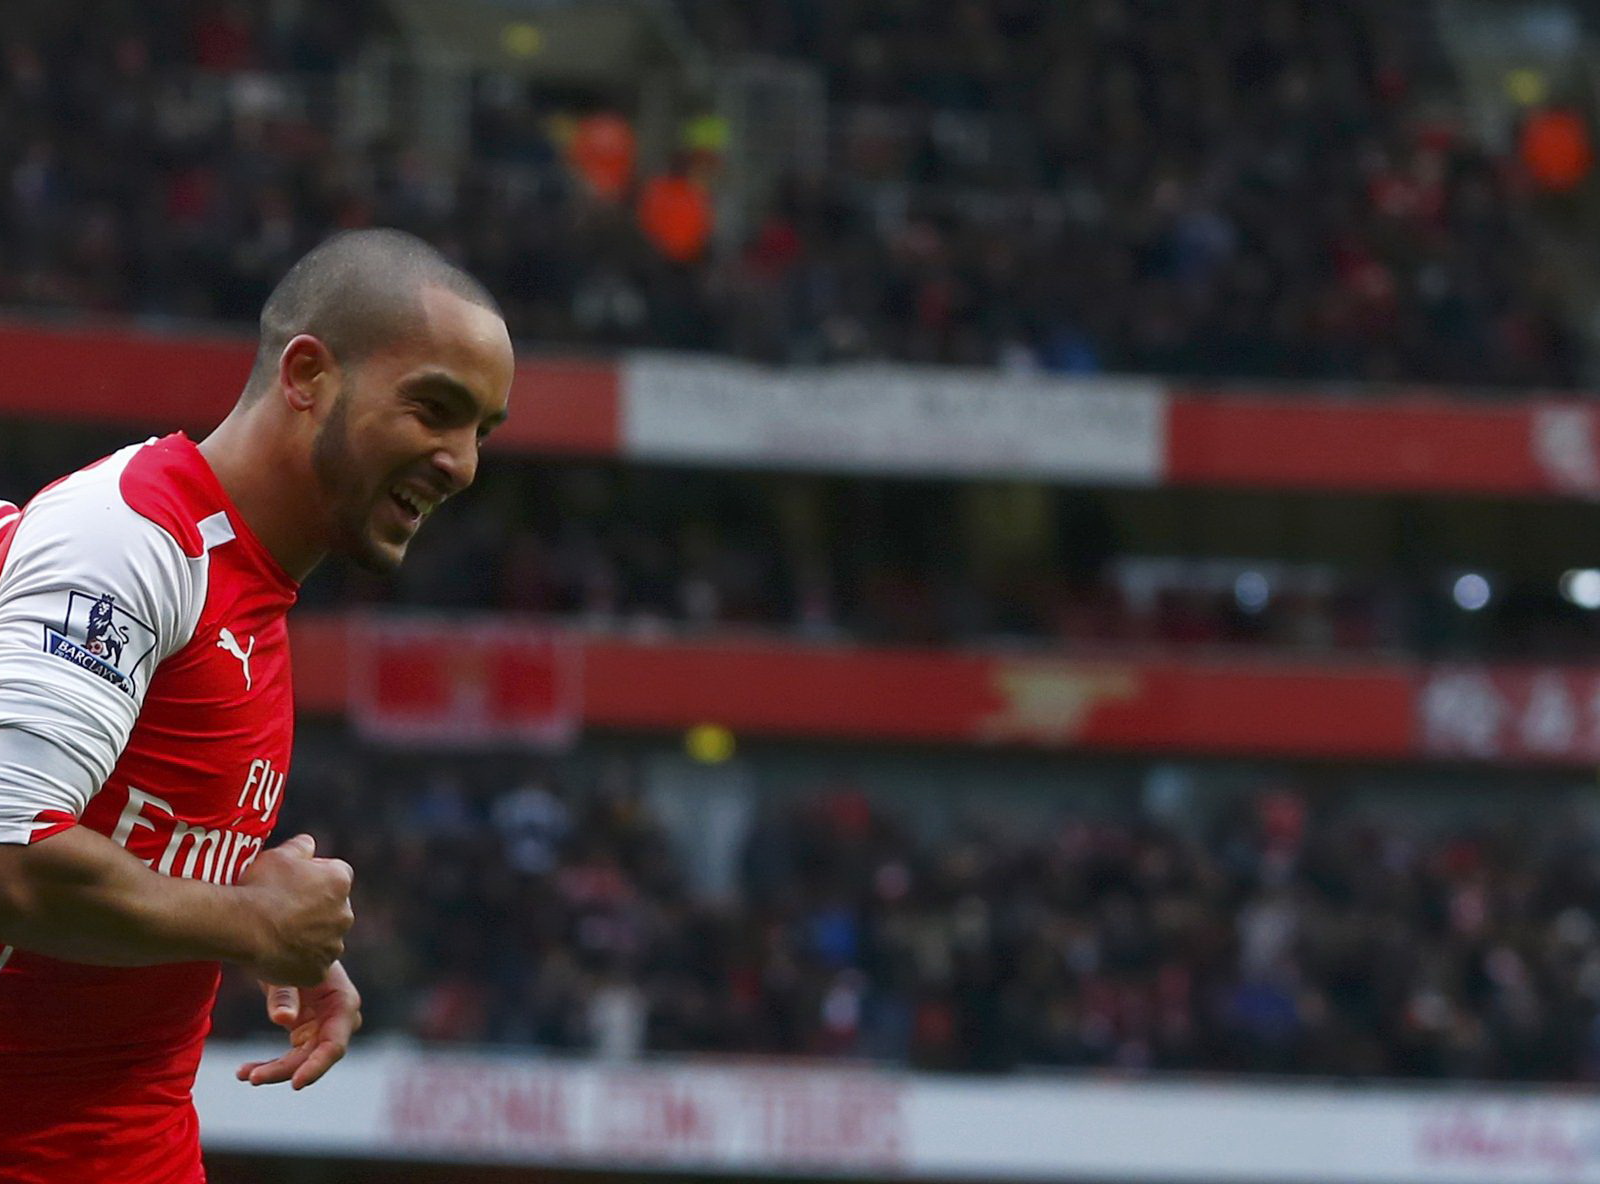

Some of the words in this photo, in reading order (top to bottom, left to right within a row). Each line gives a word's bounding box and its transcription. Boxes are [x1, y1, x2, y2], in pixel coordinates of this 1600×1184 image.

[58, 640, 118, 685] BARCLAYS
[237, 758, 284, 823] Fly
[111, 785, 273, 886] Emira
